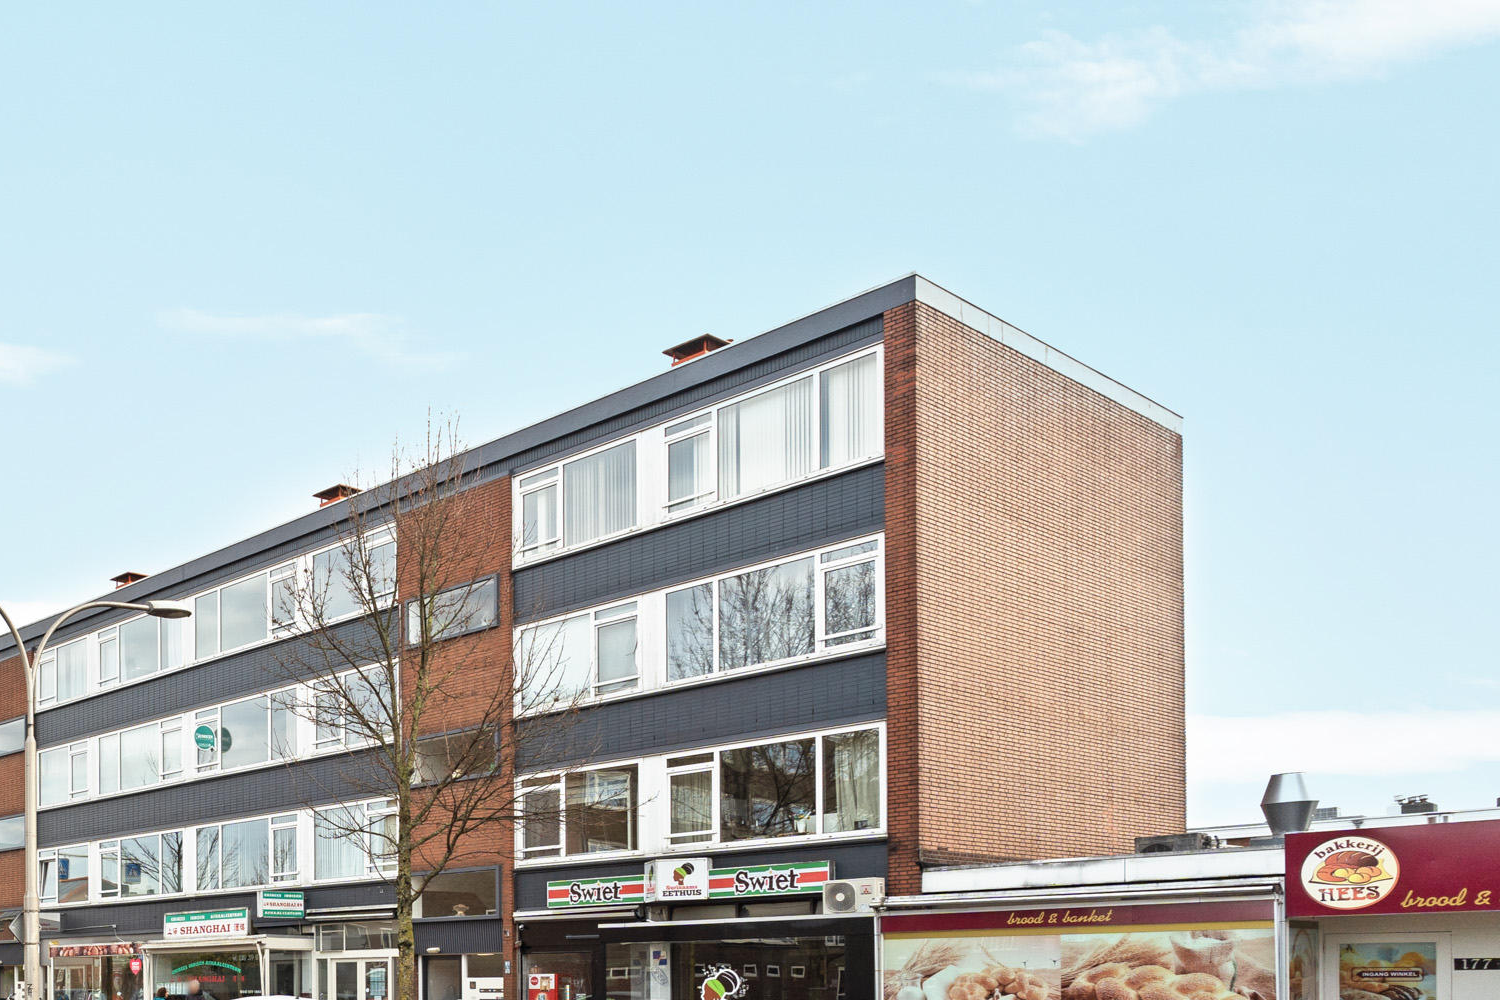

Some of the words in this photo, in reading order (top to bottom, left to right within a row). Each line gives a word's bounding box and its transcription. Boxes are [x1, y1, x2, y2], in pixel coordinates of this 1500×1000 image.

[1314, 839, 1386, 859] bakkerij
[735, 869, 799, 895] Swiet
[570, 881, 621, 902] Swiet
[662, 889, 702, 897] EETHUIS
[1318, 886, 1381, 902] HEES
[1400, 888, 1468, 908] brood
[1474, 890, 1492, 906] &
[1007, 911, 1045, 925] brood
[1048, 913, 1058, 924] &
[1062, 909, 1113, 923] banket
[180, 924, 231, 935] SHANGHAI
[1461, 958, 1493, 970] 177
